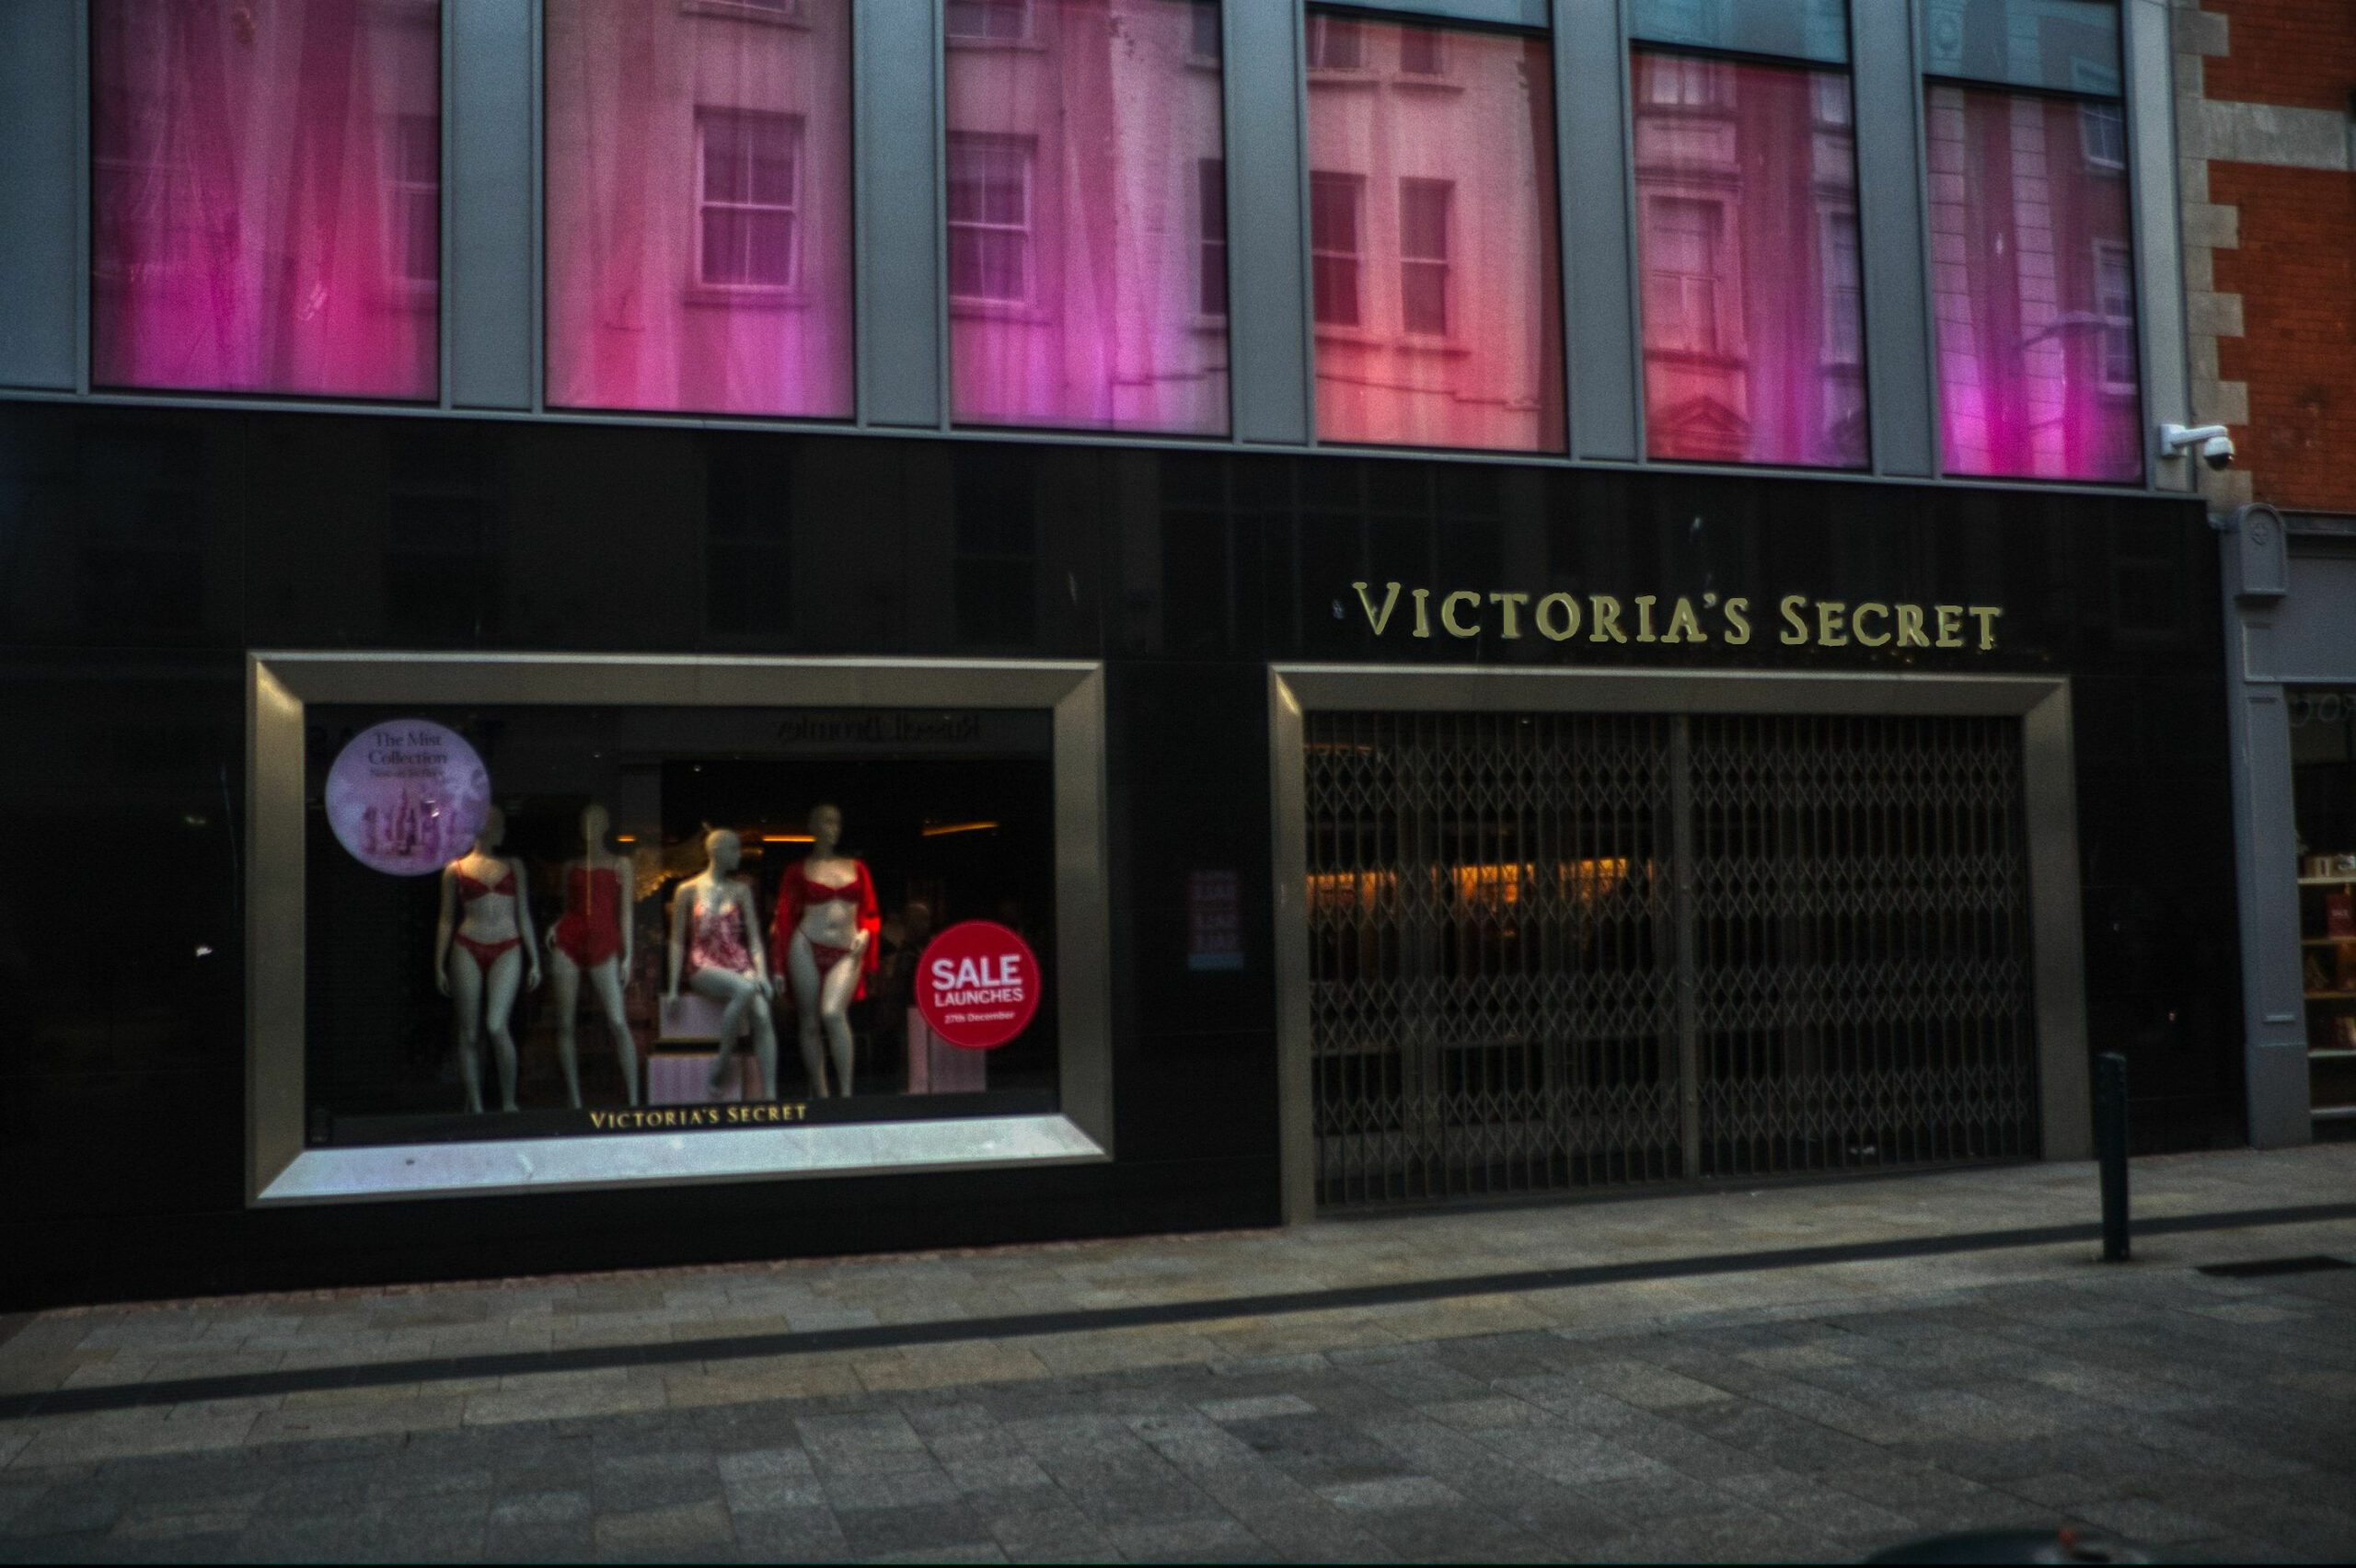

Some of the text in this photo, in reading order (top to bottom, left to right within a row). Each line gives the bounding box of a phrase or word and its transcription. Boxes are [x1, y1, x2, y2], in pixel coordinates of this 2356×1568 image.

[1352, 582, 2004, 651] VICTORIA'S SECRET
[375, 732, 403, 746] The
[368, 750, 448, 765] Collection
[931, 953, 1023, 991] SALE
[933, 987, 1024, 1008] LAUNCHES
[967, 1011, 1015, 1022] December
[589, 1103, 807, 1129] VICTORIA'S SECRET
